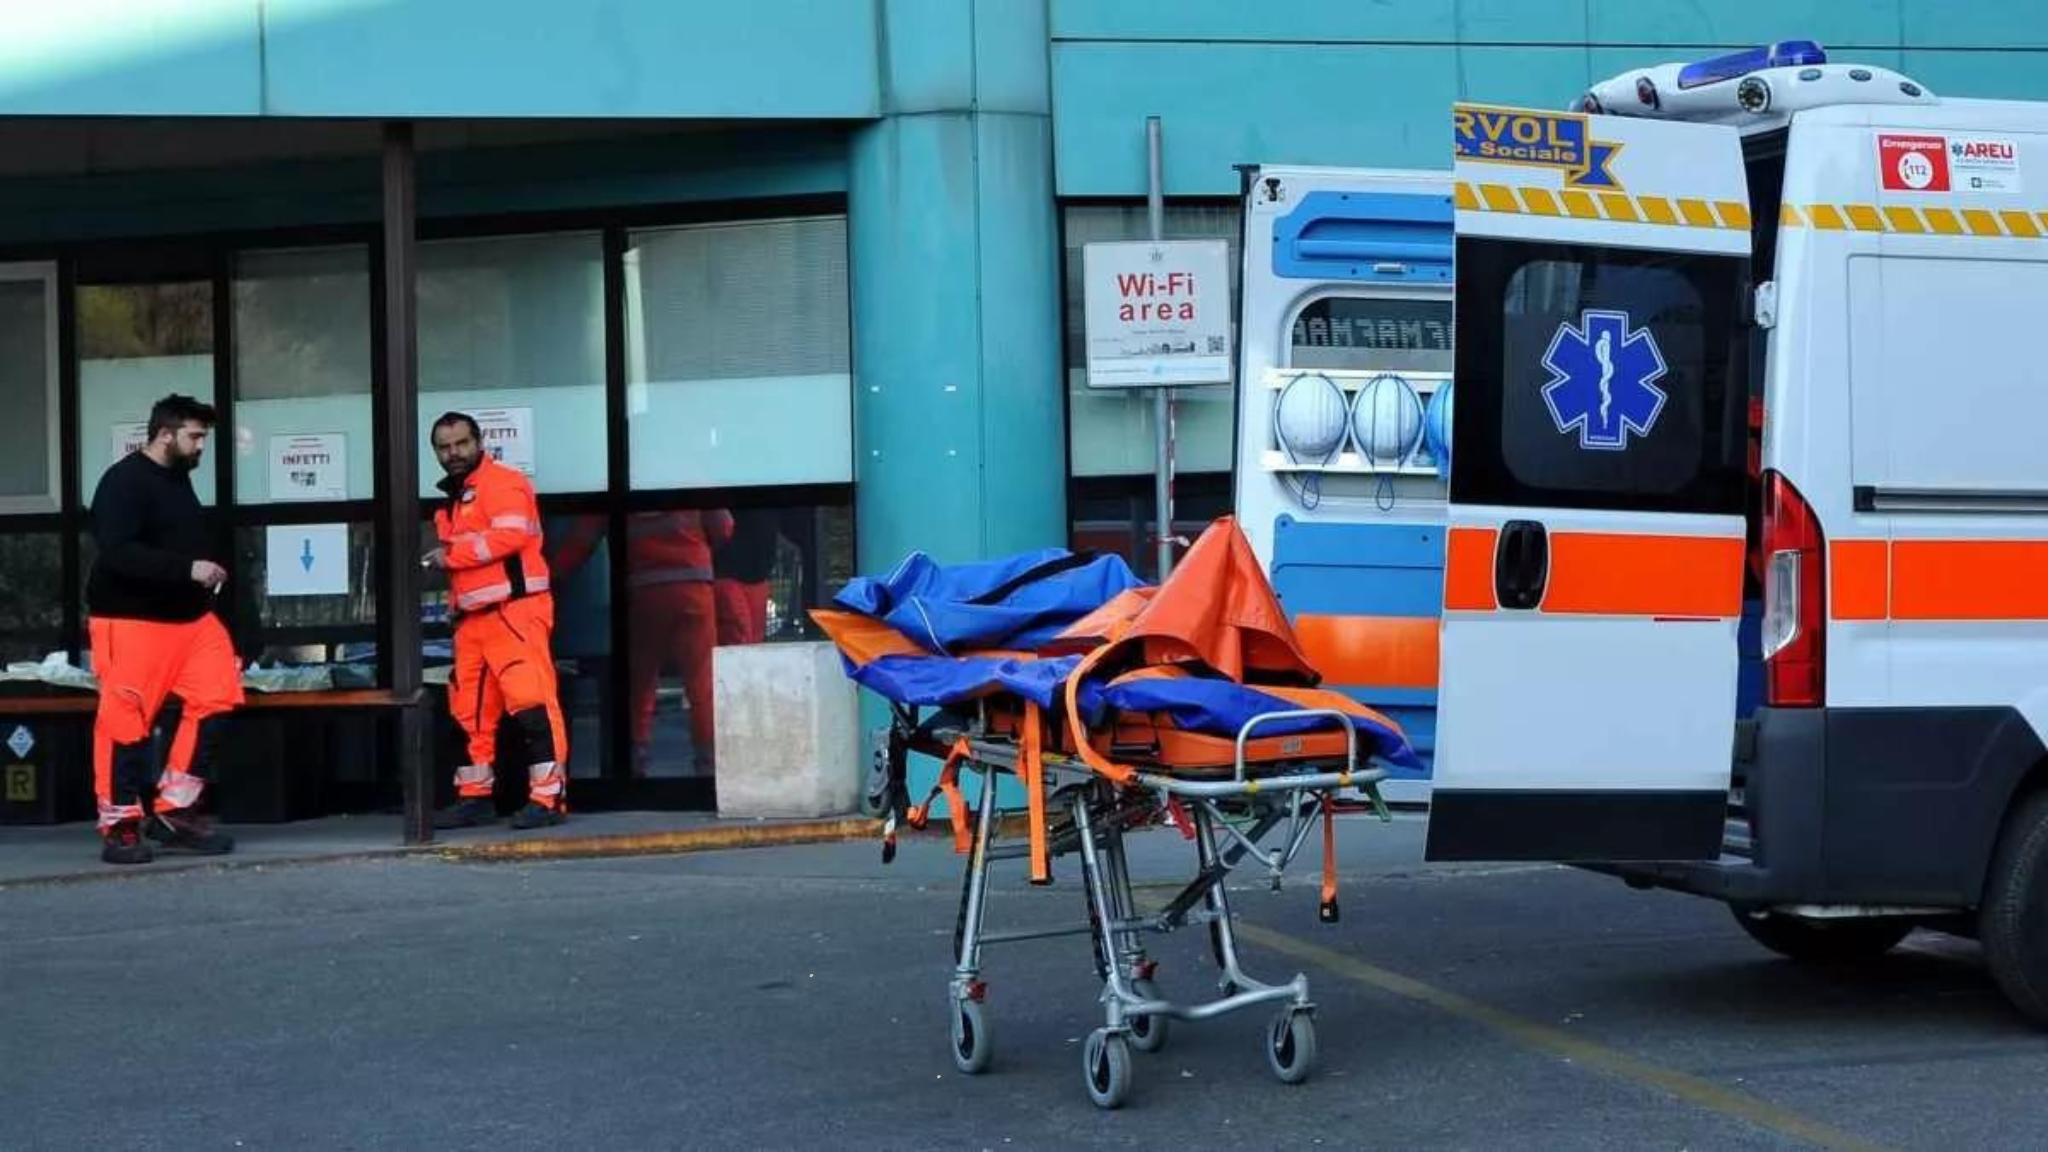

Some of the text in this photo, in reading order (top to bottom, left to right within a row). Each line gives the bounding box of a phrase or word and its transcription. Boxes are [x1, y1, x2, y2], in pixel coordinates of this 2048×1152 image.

[1479, 141, 1577, 162] Sociale
[1964, 142, 2013, 159] AREU
[1909, 165, 1926, 175] 112
[1118, 272, 1193, 297] Wi-Fi
[1119, 302, 1194, 321] area
[482, 427, 518, 439] FETTI
[282, 453, 330, 465] INFETTI
[13, 771, 30, 794] R
